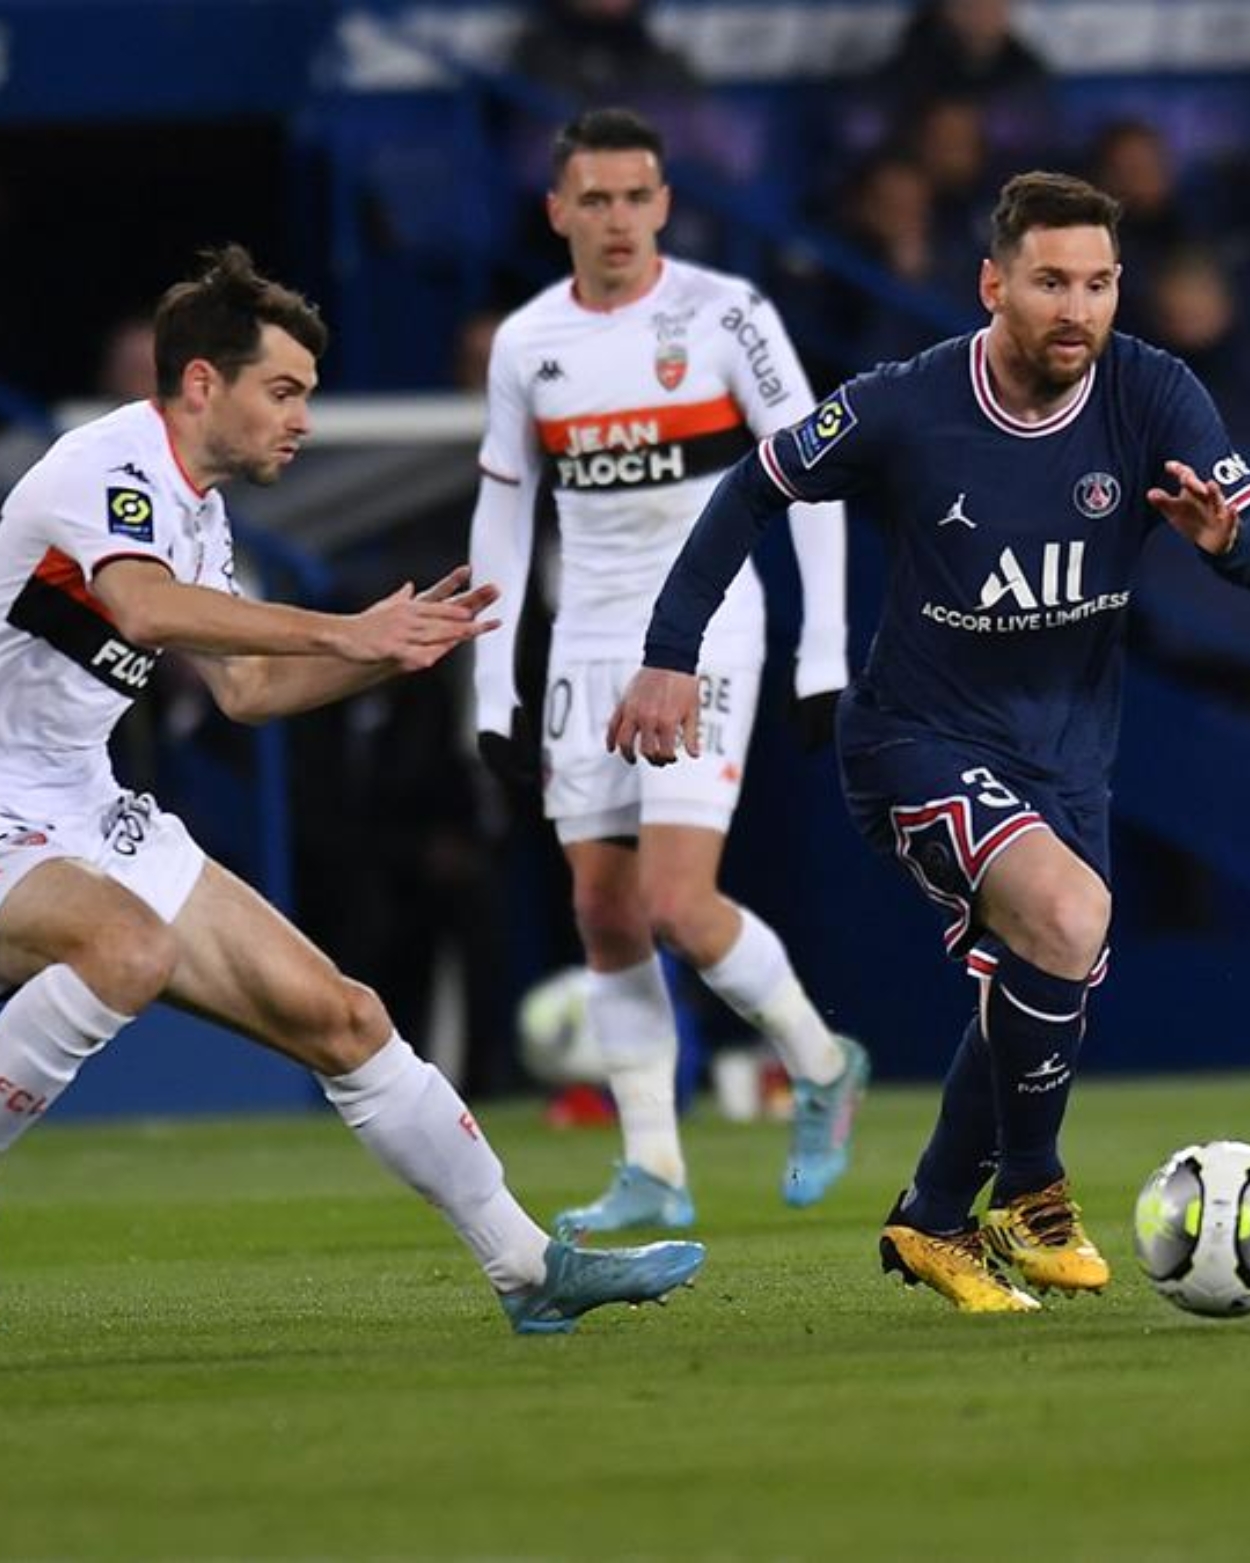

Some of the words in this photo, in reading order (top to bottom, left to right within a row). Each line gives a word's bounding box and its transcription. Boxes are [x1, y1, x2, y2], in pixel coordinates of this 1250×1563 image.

[721, 305, 791, 408] actual
[566, 419, 659, 458] JEAN
[921, 602, 992, 632] ACCOR
[997, 613, 1040, 631] LIVE
[1046, 590, 1130, 627] LIMITLESS
